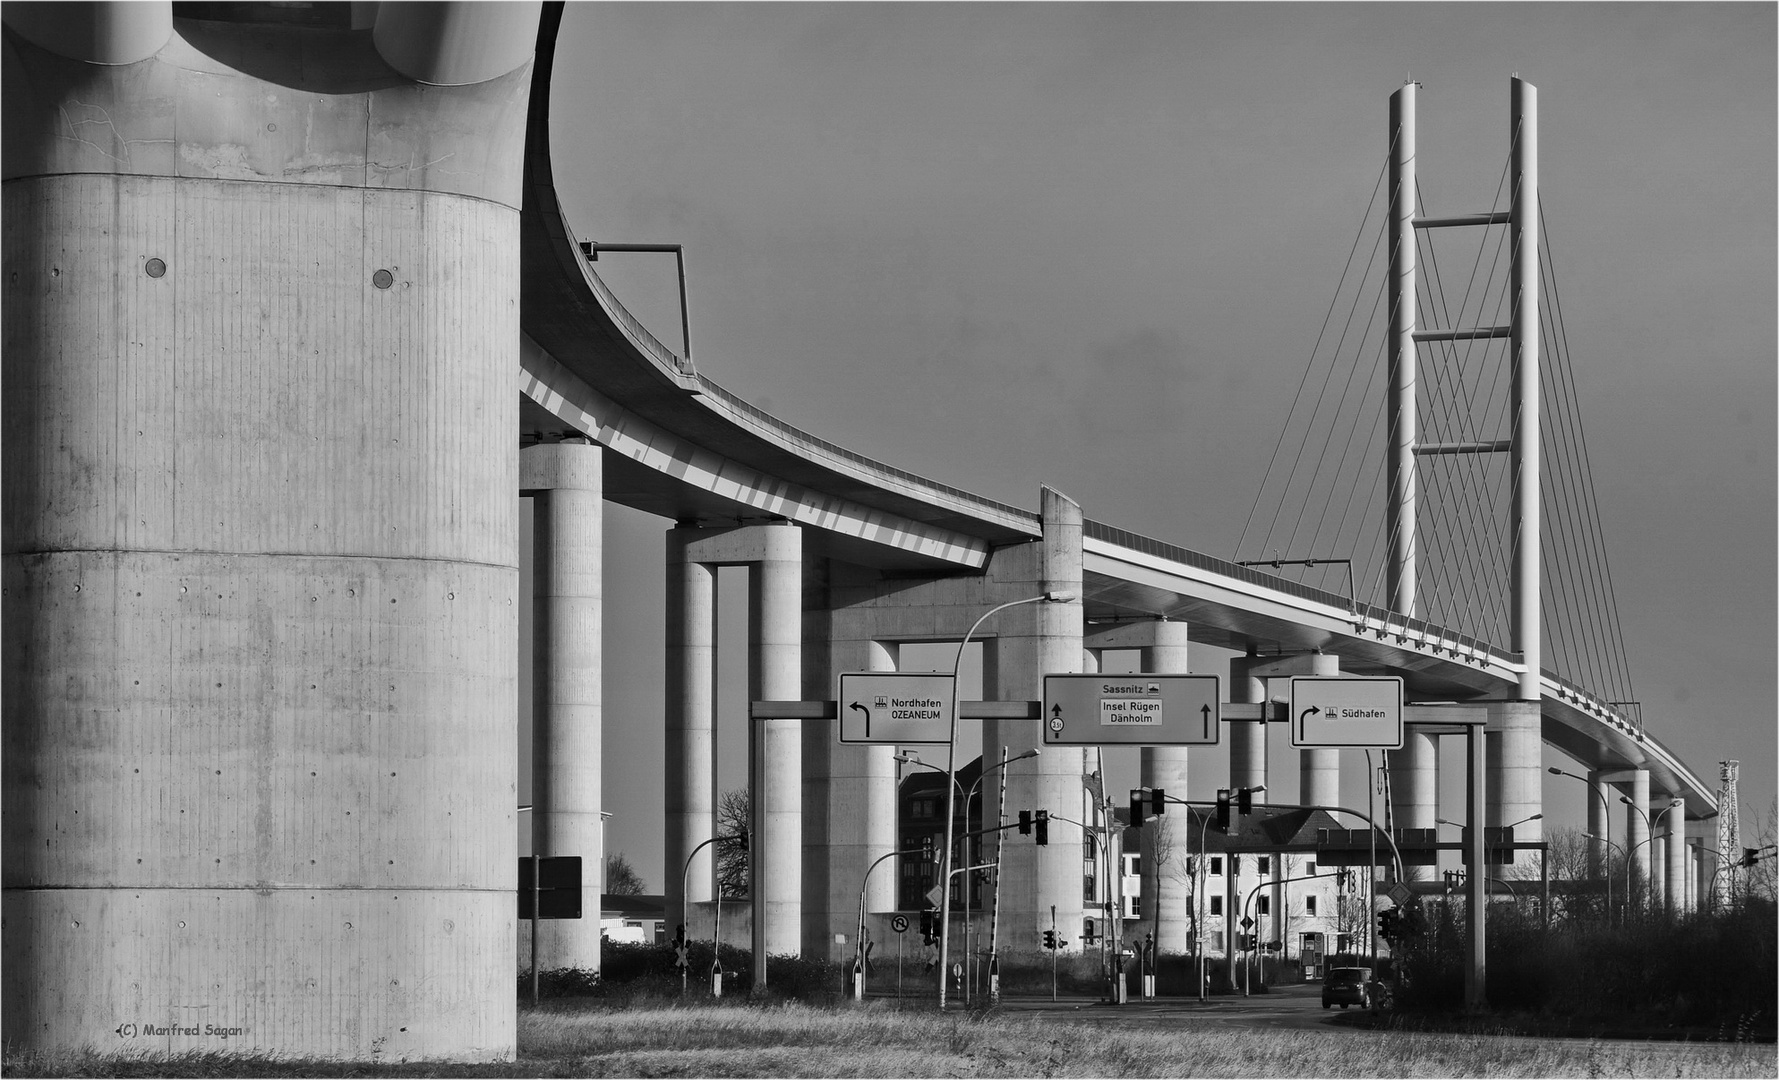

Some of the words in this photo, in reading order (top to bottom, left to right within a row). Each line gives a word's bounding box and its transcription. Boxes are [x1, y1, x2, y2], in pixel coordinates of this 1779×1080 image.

[1102, 685, 1144, 694] Sassnitz
[891, 698, 942, 708] Nordhafen
[1103, 702, 1127, 711] Insel
[1130, 701, 1160, 713] Rügen
[891, 710, 941, 719] OZEANEUM
[1110, 713, 1153, 723] Dänholm
[1341, 708, 1386, 718] Südhafen
